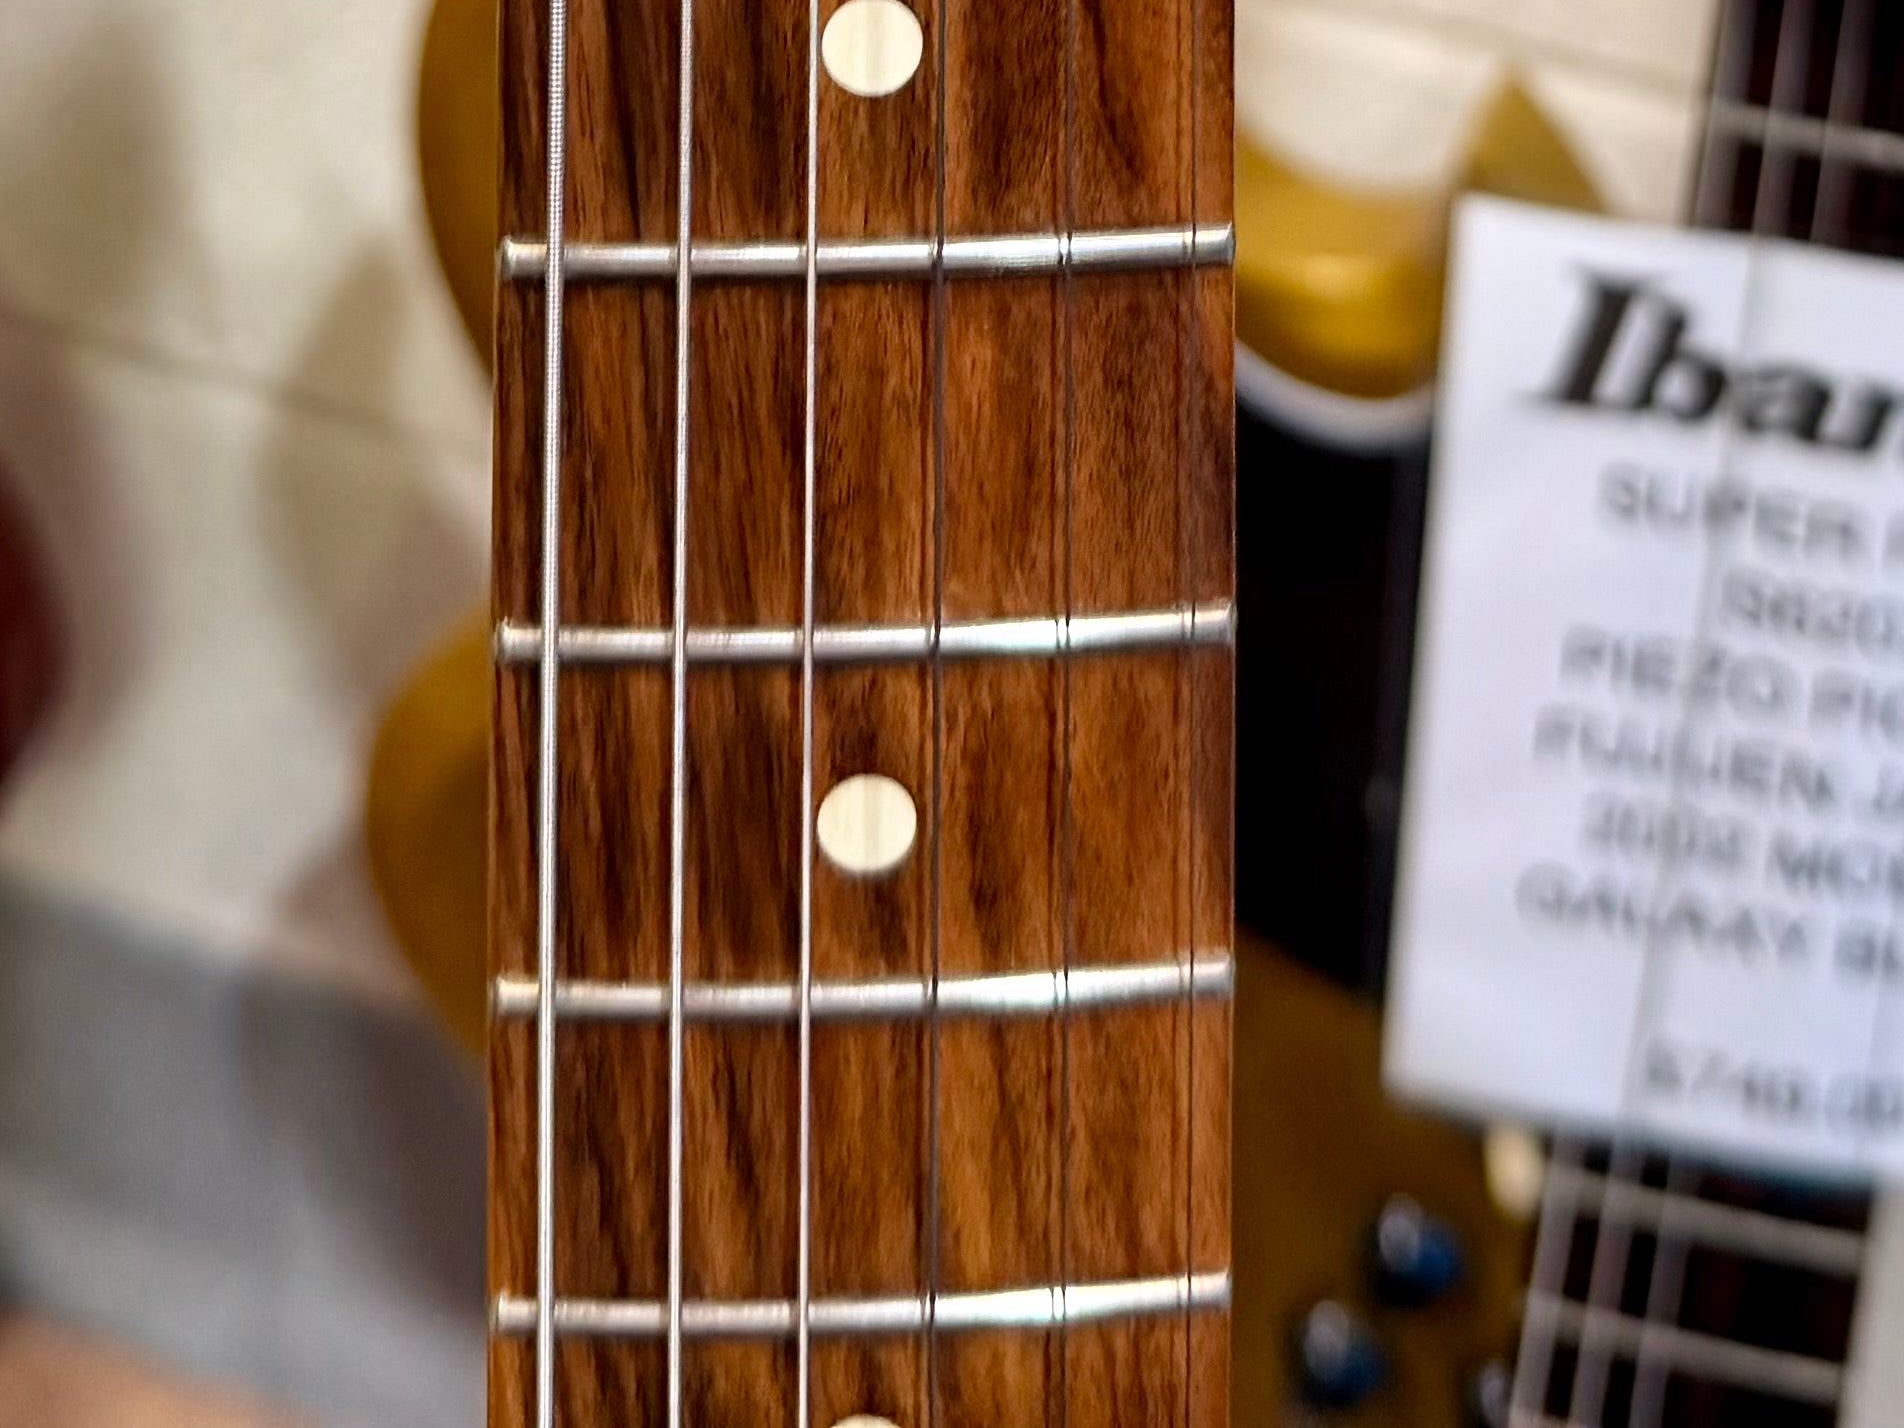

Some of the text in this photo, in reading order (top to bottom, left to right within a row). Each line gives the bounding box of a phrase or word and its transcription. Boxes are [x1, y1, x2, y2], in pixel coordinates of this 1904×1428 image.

[1602, 462, 1864, 555] SUPER
[1561, 624, 1793, 711] PIEZO
[1518, 863, 1809, 966] GALAXY
